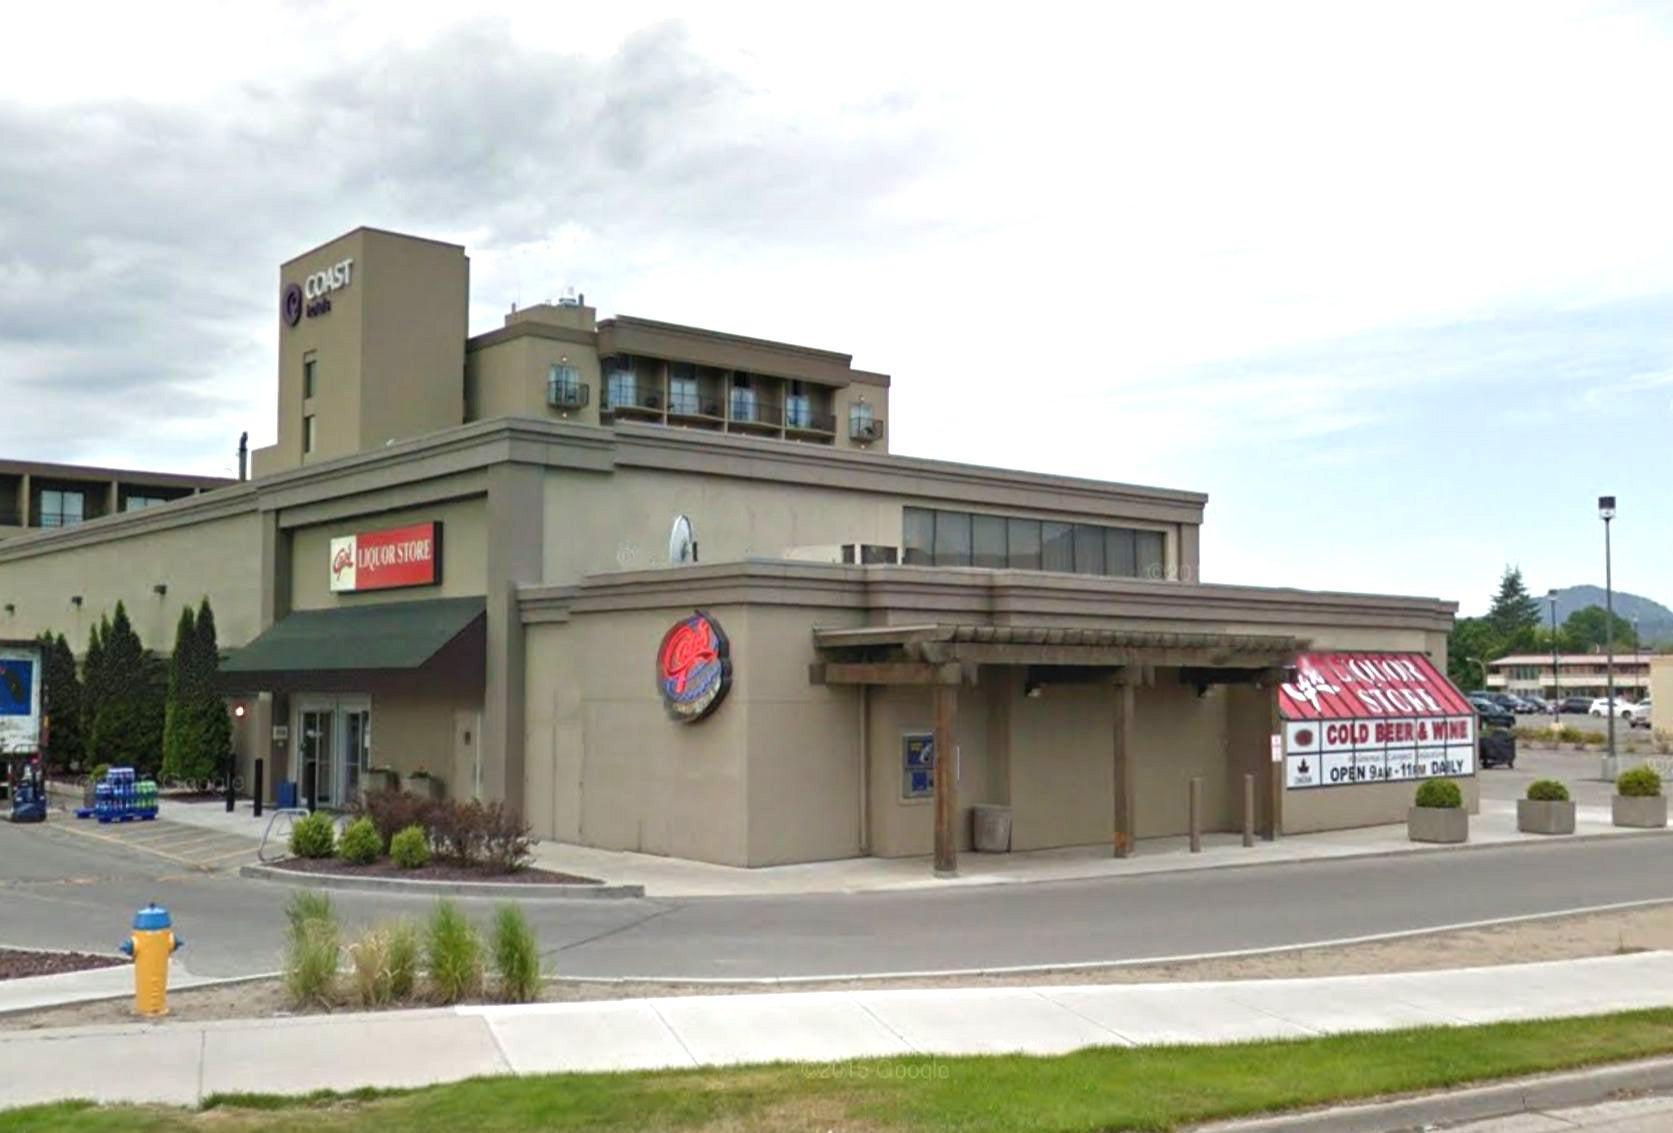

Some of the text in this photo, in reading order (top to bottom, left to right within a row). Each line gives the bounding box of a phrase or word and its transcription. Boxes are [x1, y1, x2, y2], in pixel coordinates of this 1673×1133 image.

[305, 258, 354, 299] COAST
[358, 544, 396, 572] LIQUOR
[397, 539, 432, 564] STORE
[1327, 720, 1468, 745] COLD BEER & WINE
[1330, 765, 1366, 782] OPEN
[1431, 760, 1465, 775] DAILY
